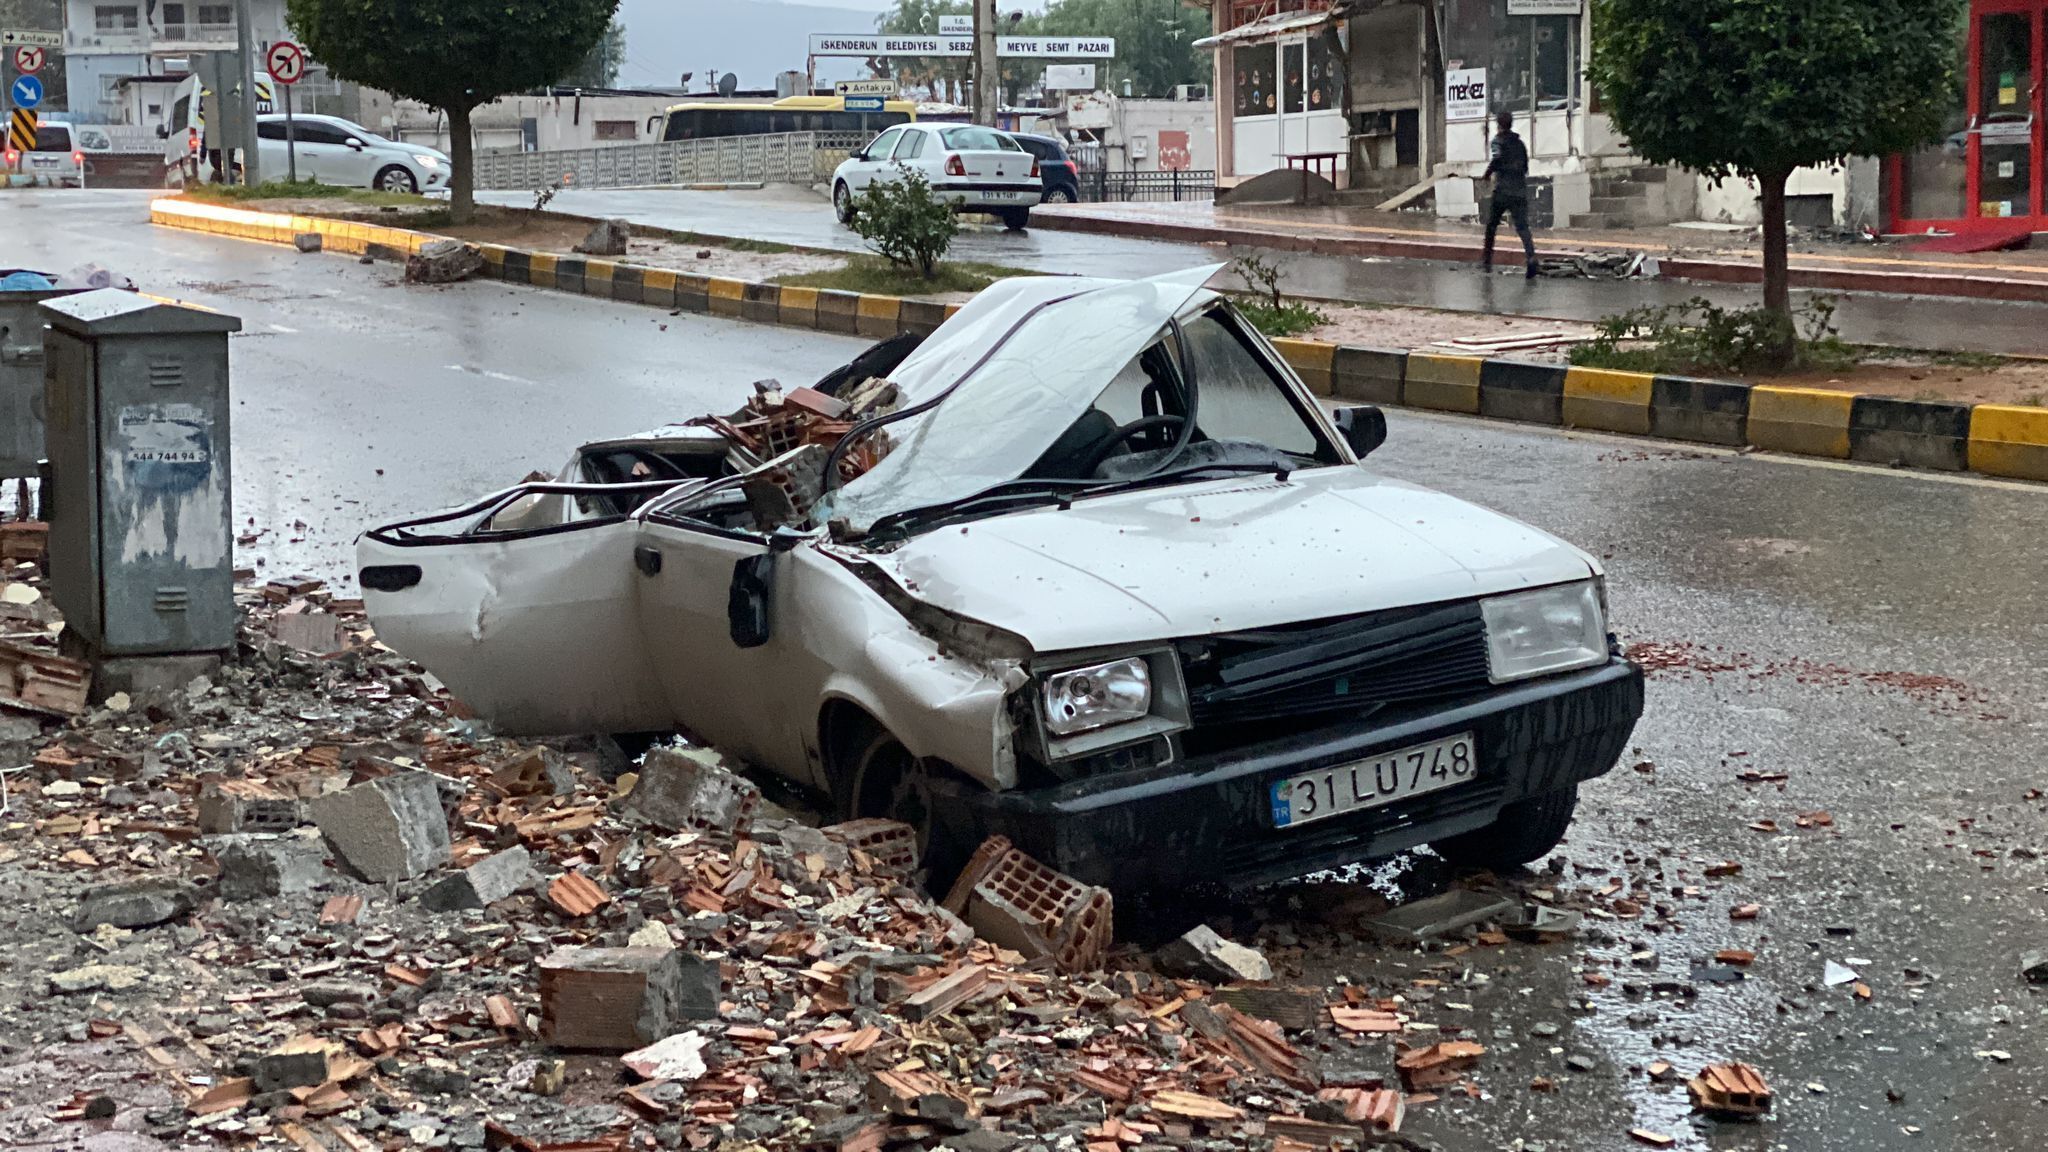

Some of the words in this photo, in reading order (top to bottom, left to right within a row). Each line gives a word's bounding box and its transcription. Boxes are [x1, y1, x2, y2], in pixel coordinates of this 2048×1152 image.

[20, 33, 59, 46] Antakya
[821, 40, 878, 50] İSKENDERUN
[886, 40, 937, 51] BELEDİYESİ
[949, 41, 973, 51] SEBZ
[1007, 42, 1037, 52] MEYVE
[1046, 43, 1069, 52] SEMT
[1077, 43, 1109, 52] PAZARI
[853, 84, 892, 94] Antakya
[1448, 75, 1484, 101] merkez
[157, 452, 178, 461] 744
[181, 452, 195, 461] 94
[1297, 772, 1335, 815] 31
[1351, 756, 1399, 804] LU
[1407, 741, 1470, 790] 748
[1274, 806, 1290, 819] TR
